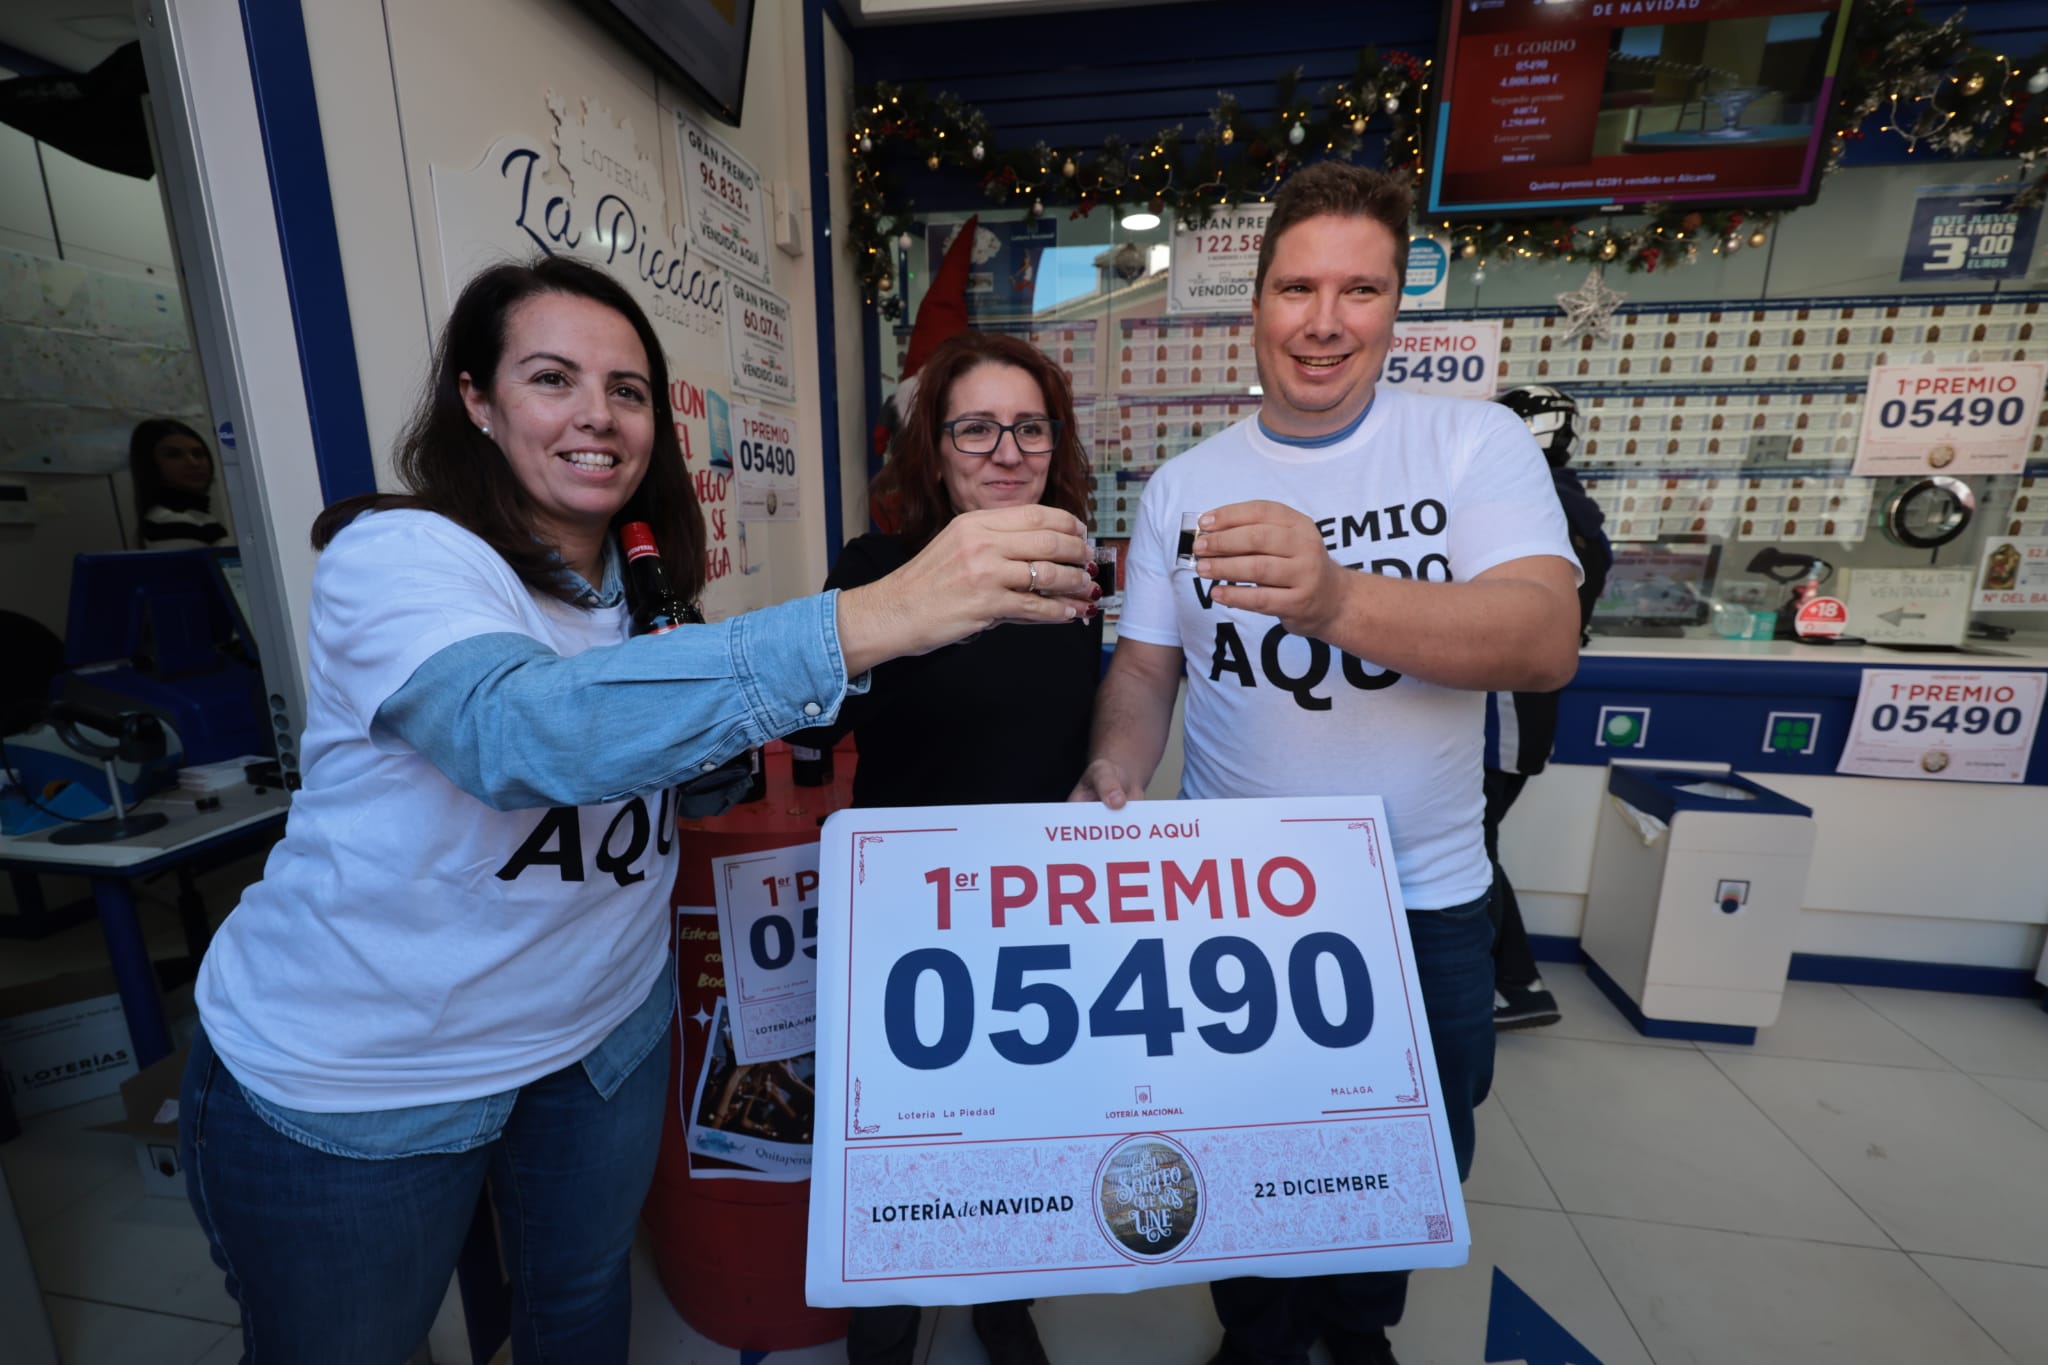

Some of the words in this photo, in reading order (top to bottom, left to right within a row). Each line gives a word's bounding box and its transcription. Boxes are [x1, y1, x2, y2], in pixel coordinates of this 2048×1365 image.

[1593, 5, 1613, 17] DE
[1619, 0, 1701, 14] NAVIDAD
[1493, 43, 1513, 57] EL
[1517, 38, 1576, 54] GORDO
[688, 130, 719, 166] GRAN
[721, 155, 754, 192] PREMIO
[501, 149, 582, 257] La
[701, 222, 738, 255] VENDIDO
[1966, 258, 2008, 270] EUROS
[1188, 284, 1248, 297] VENDIDO
[1390, 335, 1477, 353] PREMIO
[1377, 355, 1484, 384] 5490
[1915, 376, 2017, 395] PREMIO
[1879, 397, 2025, 429] 05490
[751, 420, 790, 445] PREMIO
[740, 439, 796, 477] 05490
[712, 508, 728, 541] SE
[1808, 601, 1838, 618] +18
[1909, 685, 2015, 703] PREMIO
[1871, 704, 2022, 735] 05490
[1045, 824, 1141, 842] VENDIDO
[1149, 819, 1200, 840] AQUÍ
[989, 855, 1317, 928] PREMIO
[884, 931, 1375, 1070] 05490
[755, 1020, 795, 1036] LOTERÍA
[23, 1049, 129, 1085] LOTERÍAS
[943, 1109, 955, 1118] La
[960, 1107, 996, 1117] Piedad
[1141, 1107, 1184, 1117] NACIONAL
[1116, 1166, 1182, 1205] SORTEO
[1254, 1182, 1276, 1198] 22
[1283, 1173, 1389, 1197] DICIEMBRE
[1128, 1209, 1173, 1243] UNE
